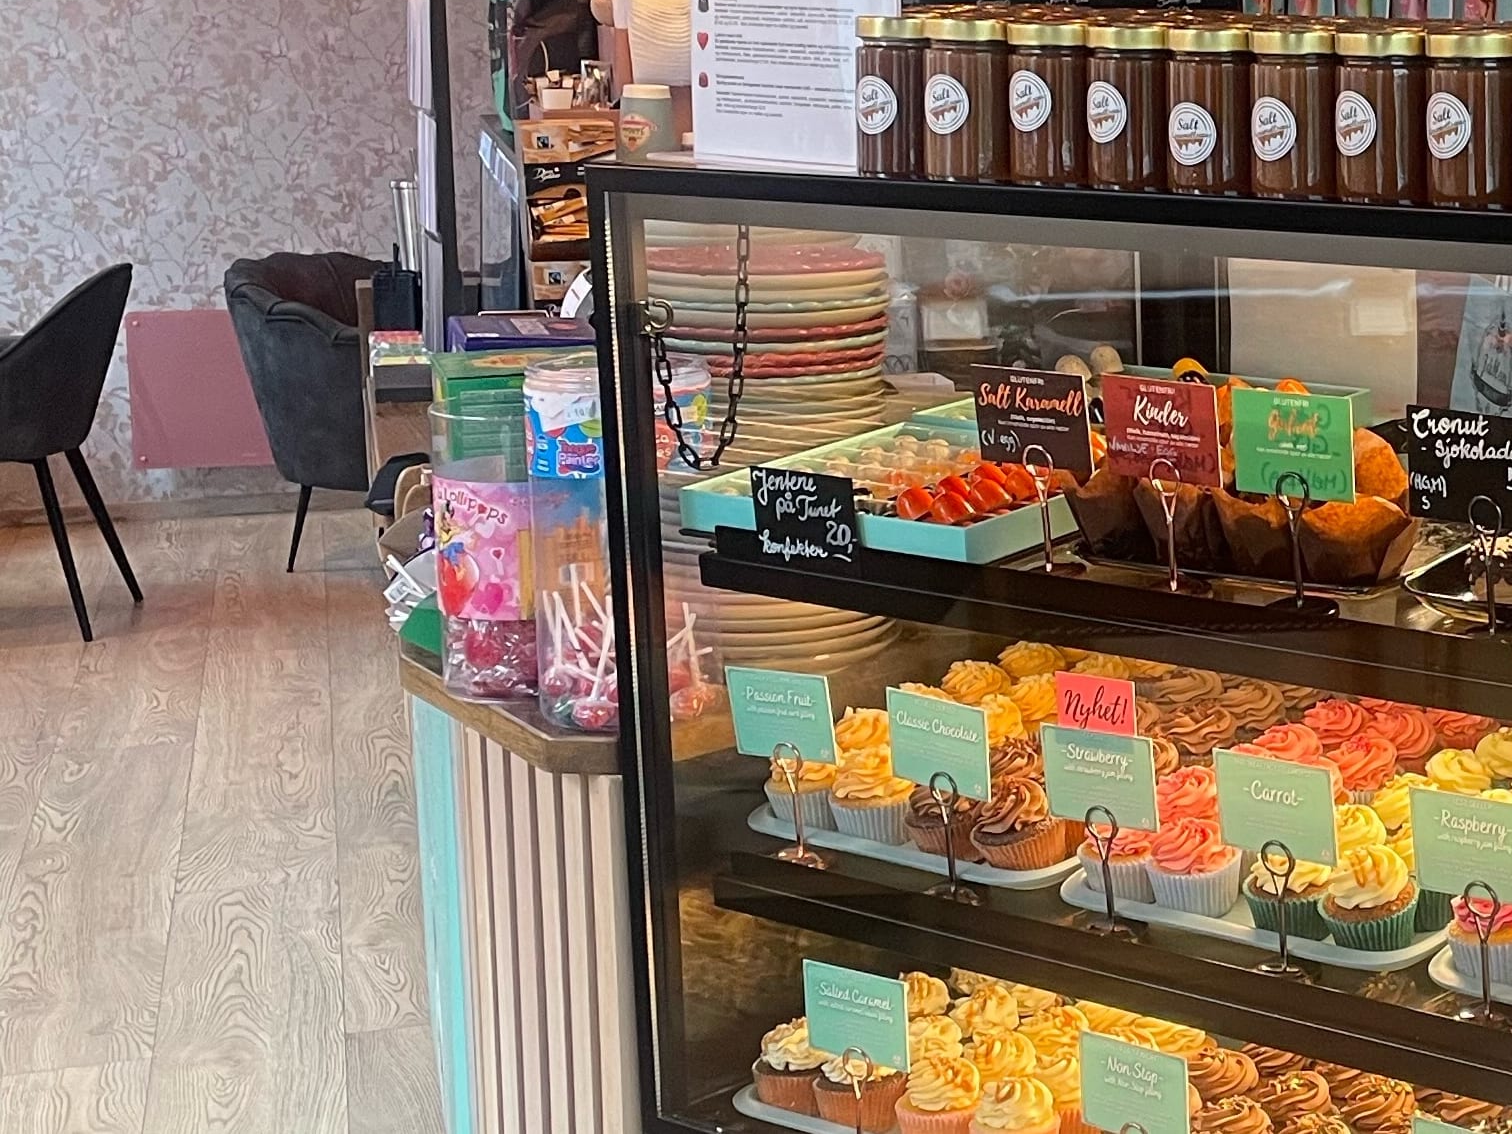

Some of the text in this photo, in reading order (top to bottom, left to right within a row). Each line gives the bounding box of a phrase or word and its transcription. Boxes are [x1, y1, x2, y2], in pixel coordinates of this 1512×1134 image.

[979, 383, 1083, 417] Salt Karamell
[1133, 395, 1188, 427] Kinder
[1411, 409, 1489, 439] Cronut
[753, 469, 817, 506] Jentene
[776, 492, 842, 521] på Tunet
[1064, 684, 1129, 729] Nyhet!
